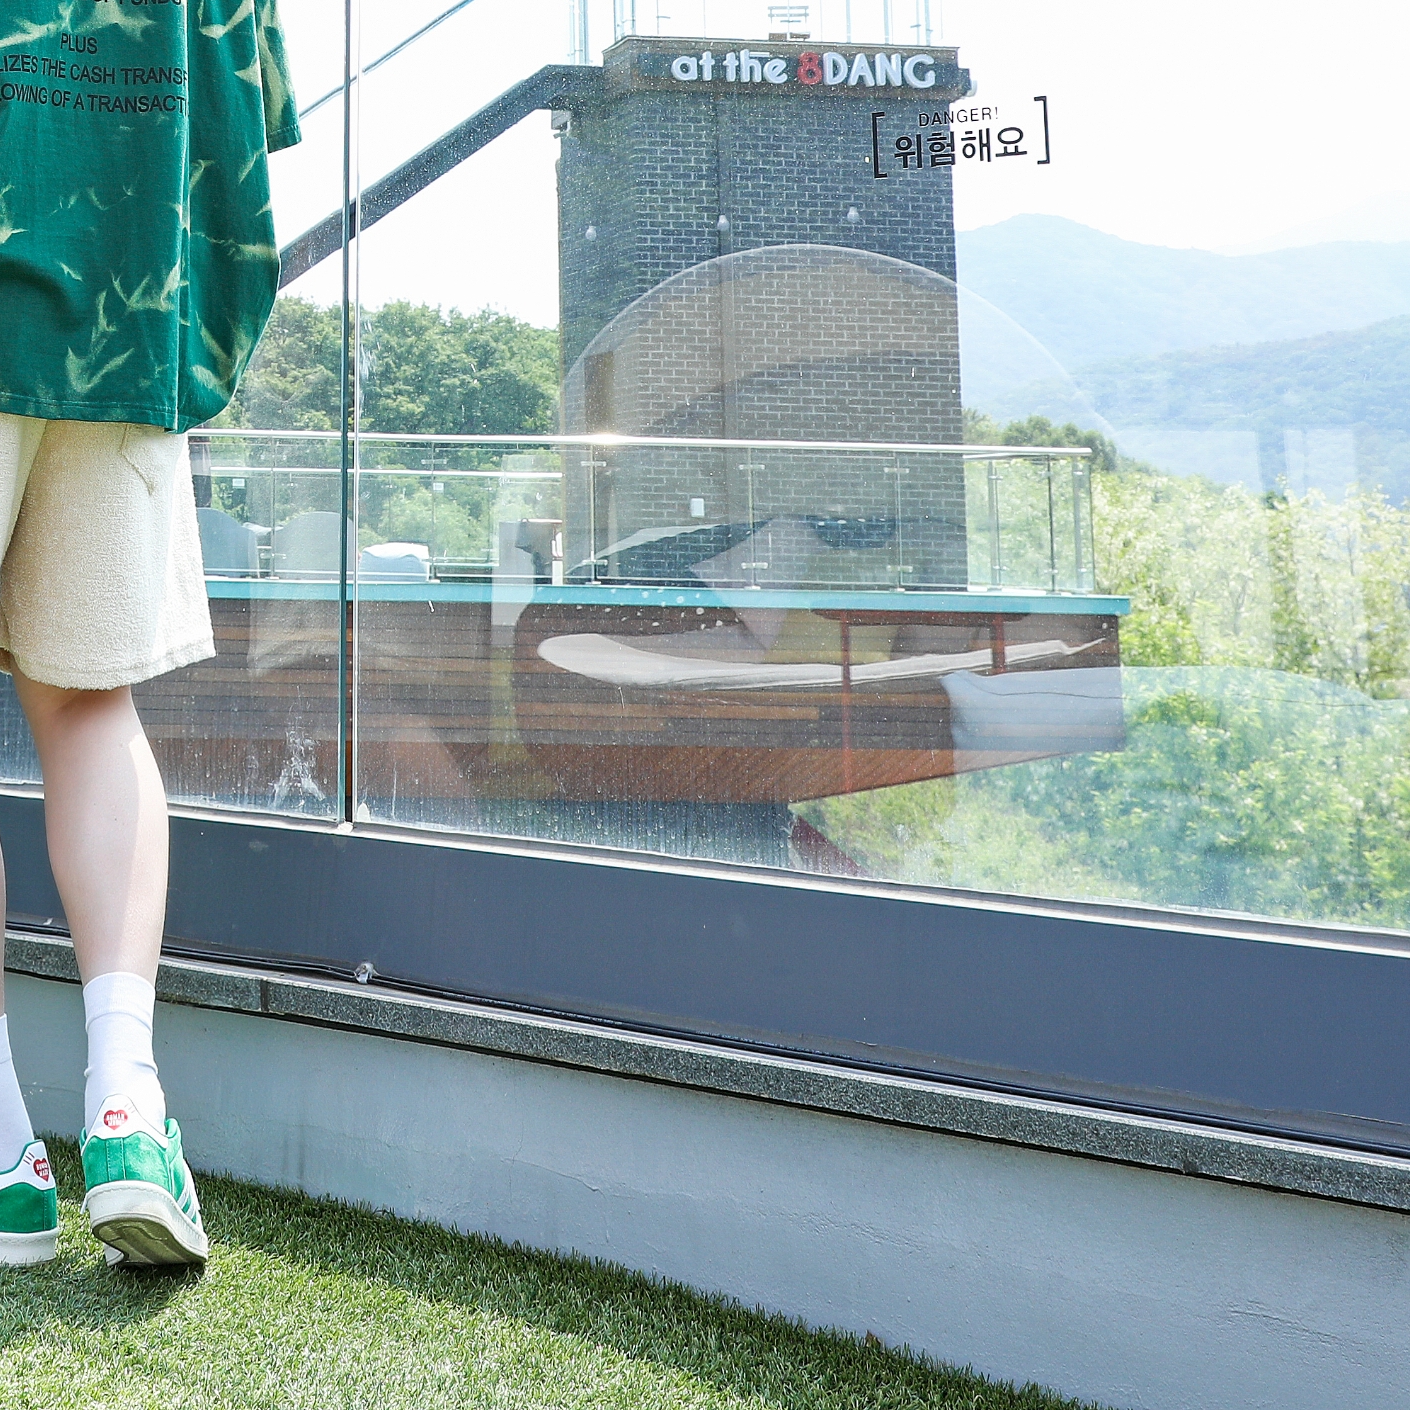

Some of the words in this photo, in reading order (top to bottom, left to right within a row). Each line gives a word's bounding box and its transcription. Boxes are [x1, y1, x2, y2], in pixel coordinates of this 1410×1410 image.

[61, 33, 98, 54] PLUS
[41, 57, 66, 78] THE
[70, 64, 115, 84] CASH
[671, 51, 715, 81] at
[723, 49, 788, 84] the
[797, 51, 936, 89] 8DANG
[51, 89, 71, 108] OF
[73, 93, 84, 110] A
[918, 106, 998, 127] DANGER!
[894, 127, 1028, 169] 위험해요
